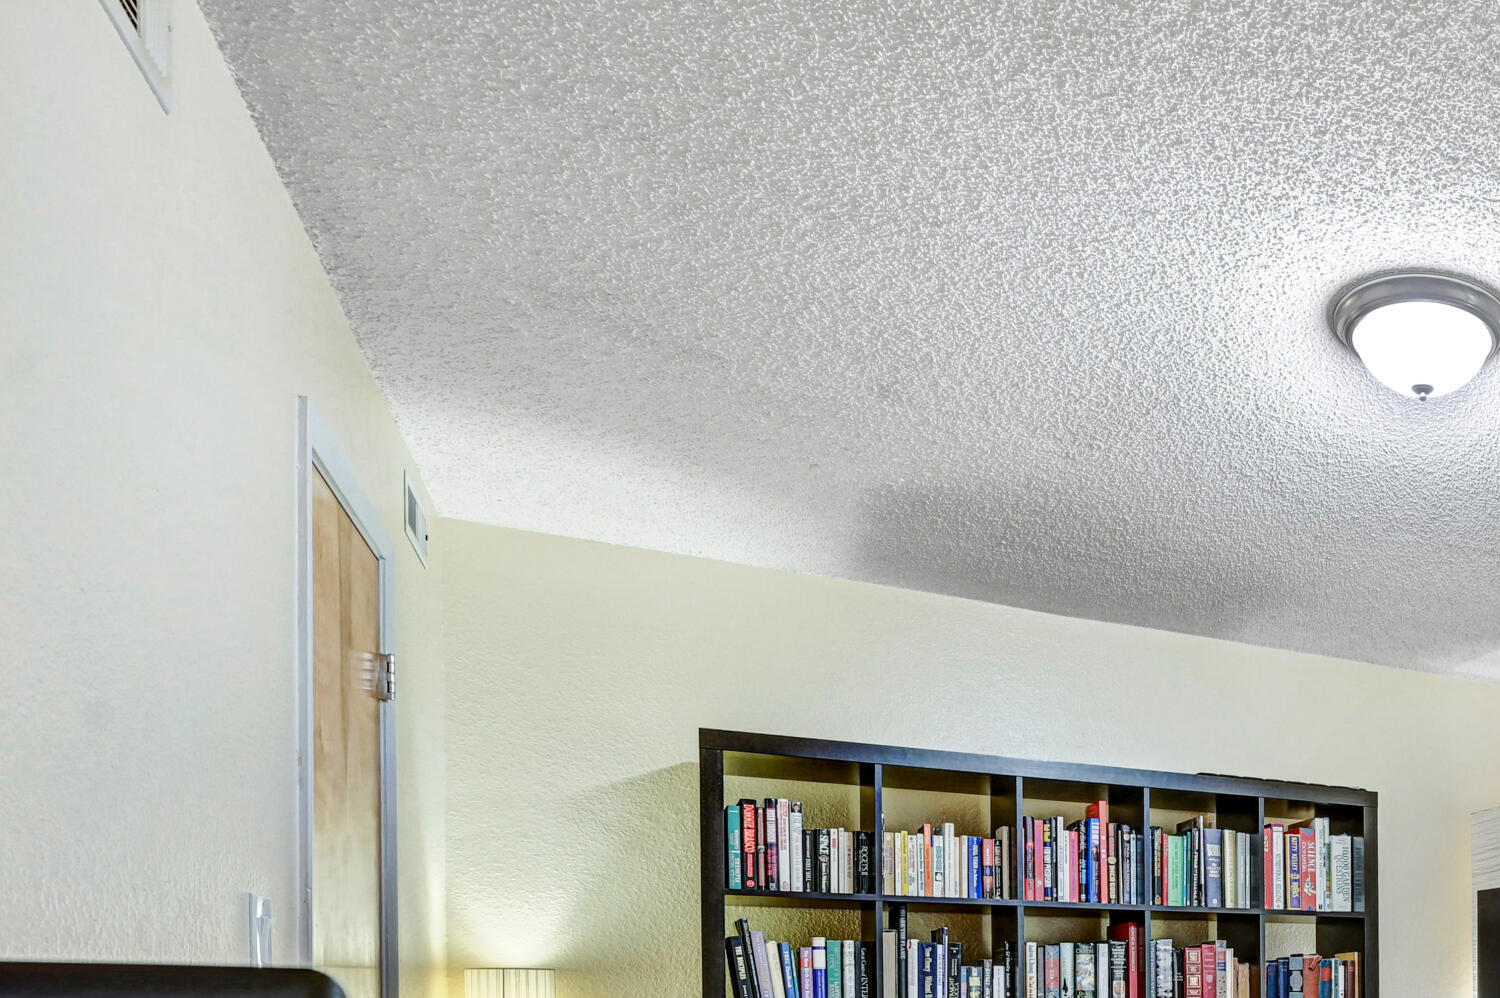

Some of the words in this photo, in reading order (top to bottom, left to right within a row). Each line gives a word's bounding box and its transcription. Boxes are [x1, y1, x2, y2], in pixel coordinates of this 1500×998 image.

[744, 804, 754, 828] DONNIE
[745, 829, 755, 852] BRASCO
[819, 835, 828, 854] SPACE
[1334, 855, 1343, 895] QUESTIONS
